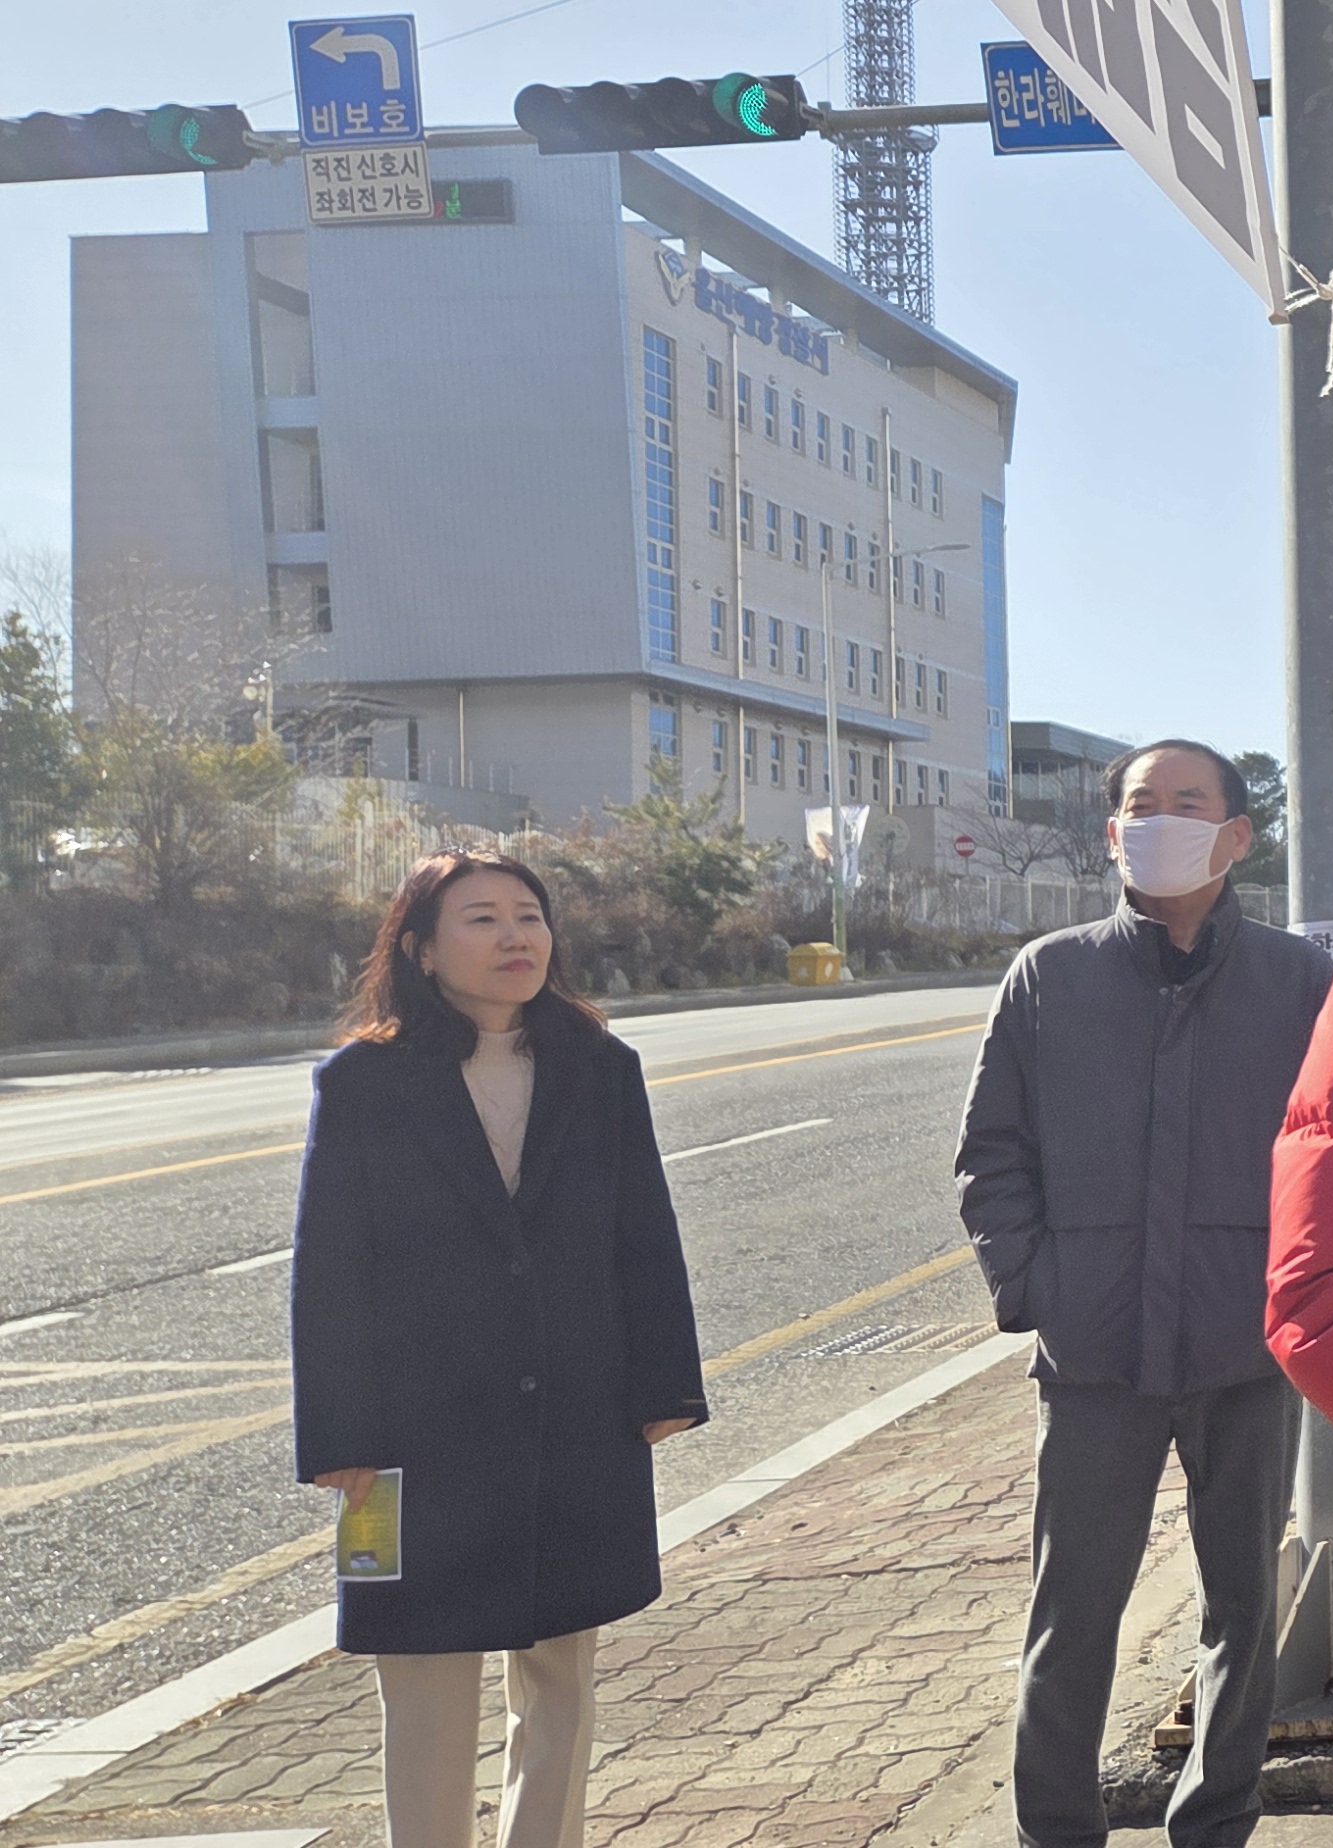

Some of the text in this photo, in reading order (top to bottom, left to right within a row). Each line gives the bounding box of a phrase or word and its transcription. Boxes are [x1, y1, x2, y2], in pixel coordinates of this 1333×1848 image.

[311, 99, 410, 137] 비보호
[315, 183, 425, 214] 좌회전 가능
